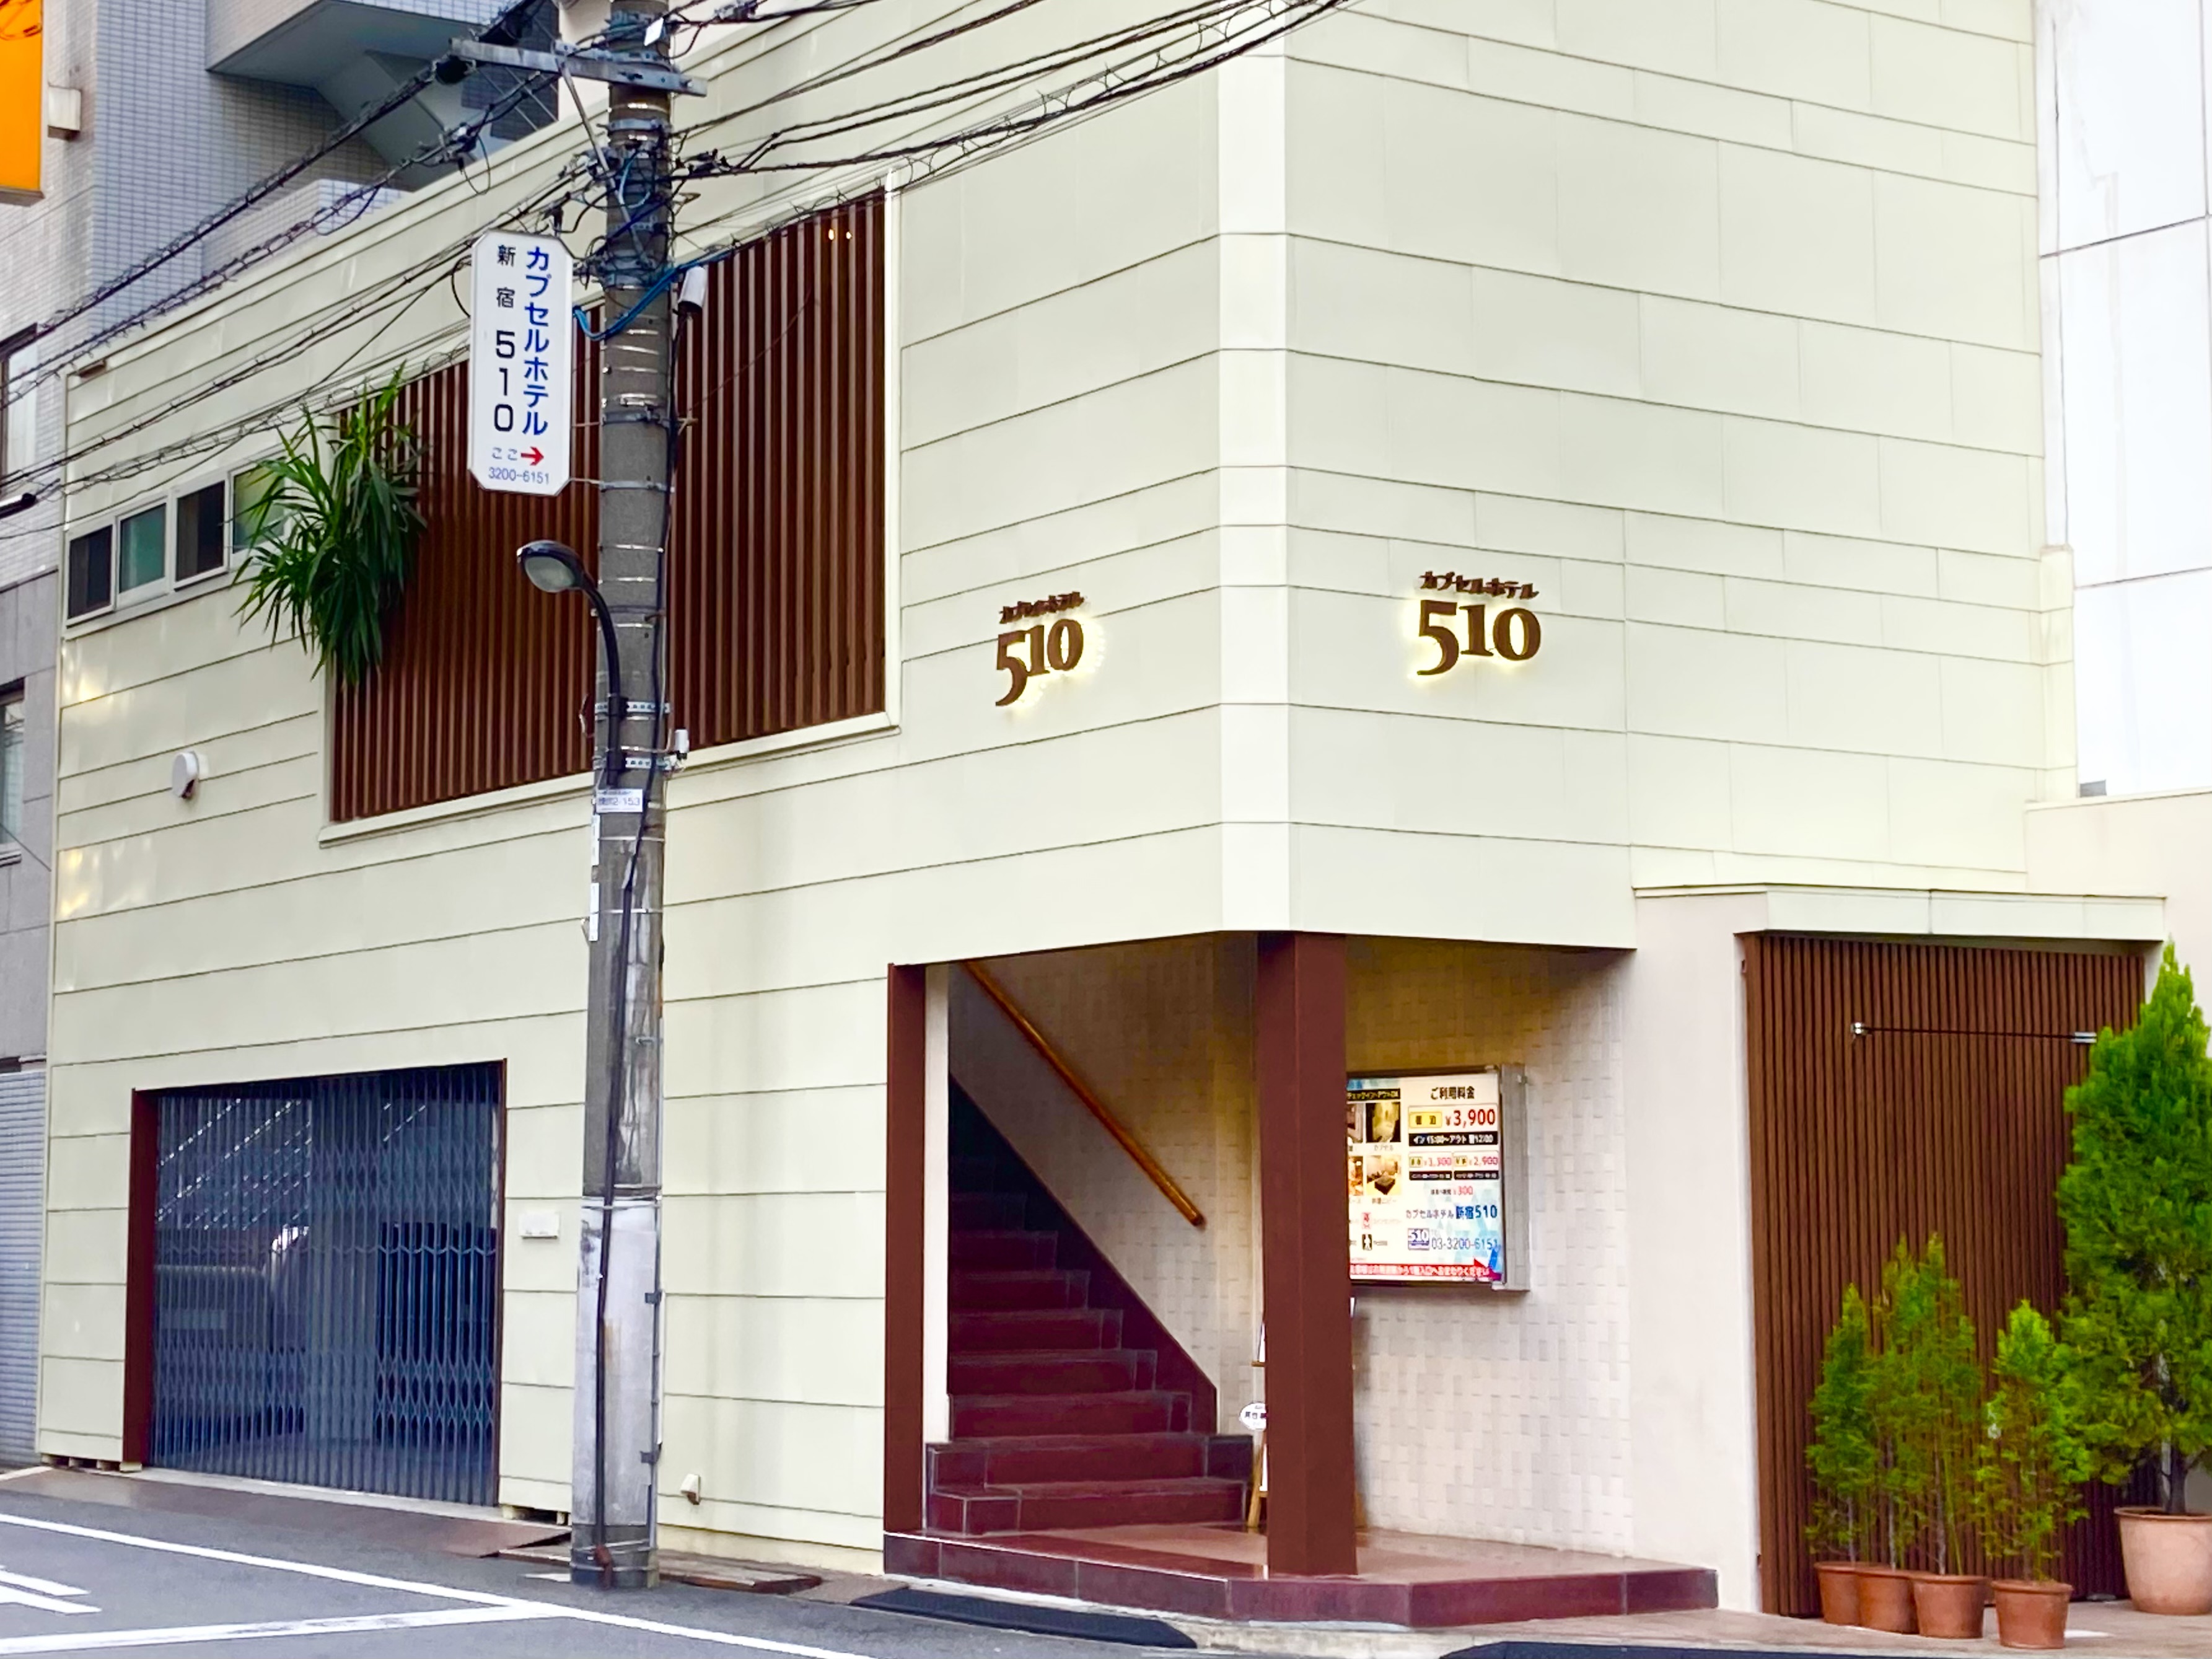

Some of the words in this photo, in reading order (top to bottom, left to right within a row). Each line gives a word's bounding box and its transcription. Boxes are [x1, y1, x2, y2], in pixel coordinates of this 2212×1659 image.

[494, 244, 516, 432] 新宿510
[522, 246, 551, 436] カプセルホテル
[488, 467, 550, 484] 3200-6151
[1420, 571, 1539, 599] カプセルホテル
[995, 618, 1084, 706] 510
[1416, 599, 1541, 675] 510
